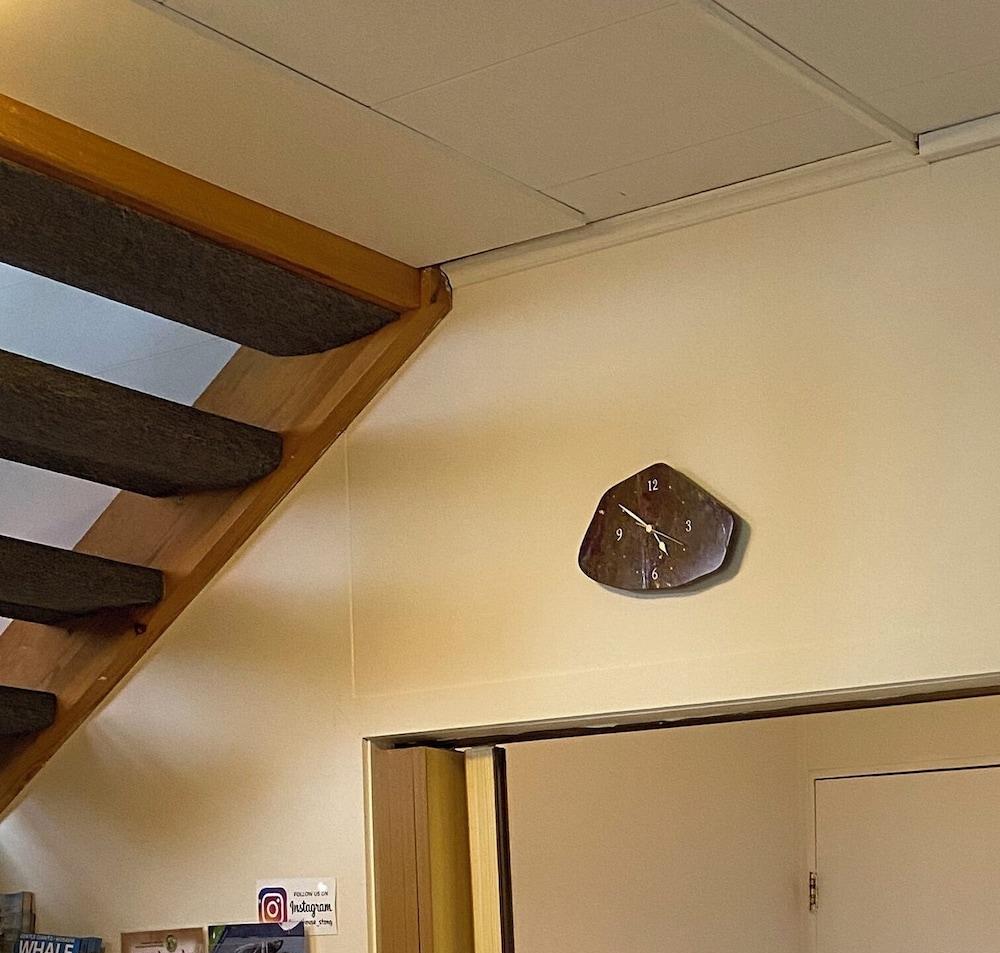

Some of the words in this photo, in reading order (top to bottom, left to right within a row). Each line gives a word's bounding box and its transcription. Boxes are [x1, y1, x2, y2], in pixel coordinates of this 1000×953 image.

[647, 479, 659, 491] 12
[685, 520, 692, 532] 3
[615, 528, 623, 541] 9
[651, 568, 658, 580] 6
[290, 900, 333, 918] Instagram
